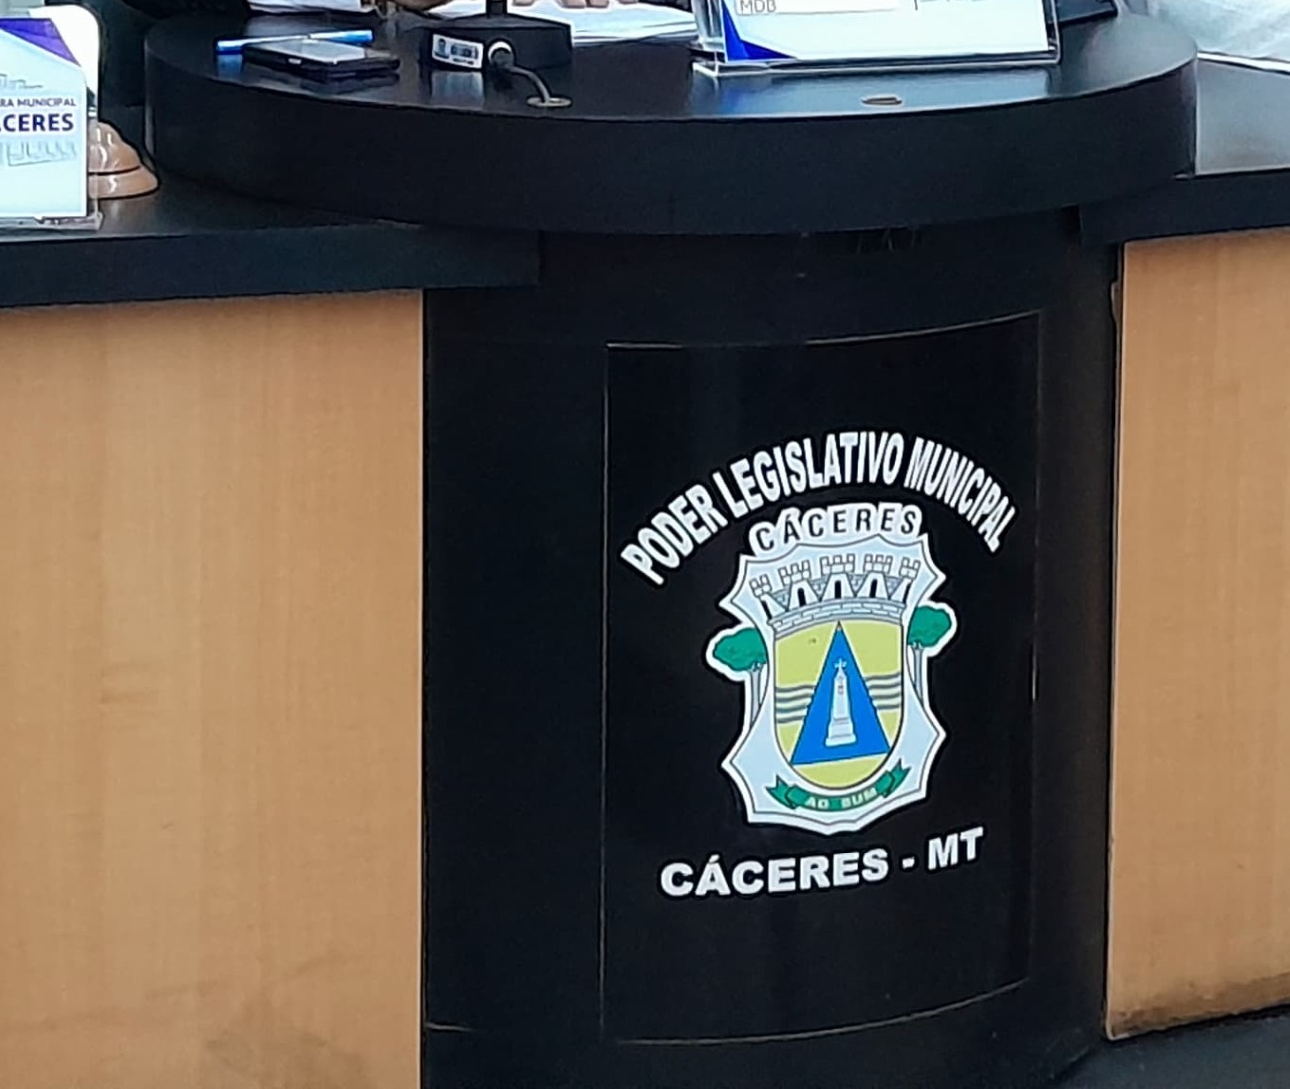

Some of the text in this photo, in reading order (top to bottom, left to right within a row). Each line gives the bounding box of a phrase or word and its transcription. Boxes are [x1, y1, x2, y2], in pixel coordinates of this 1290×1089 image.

[17, 97, 77, 108] MUNICIPAL
[620, 431, 1016, 585] PODER LEGISLATIVO MUNICIPAL
[755, 508, 917, 552] CÁCERES
[660, 854, 889, 897] CÁCERES
[928, 827, 984, 871] MT
